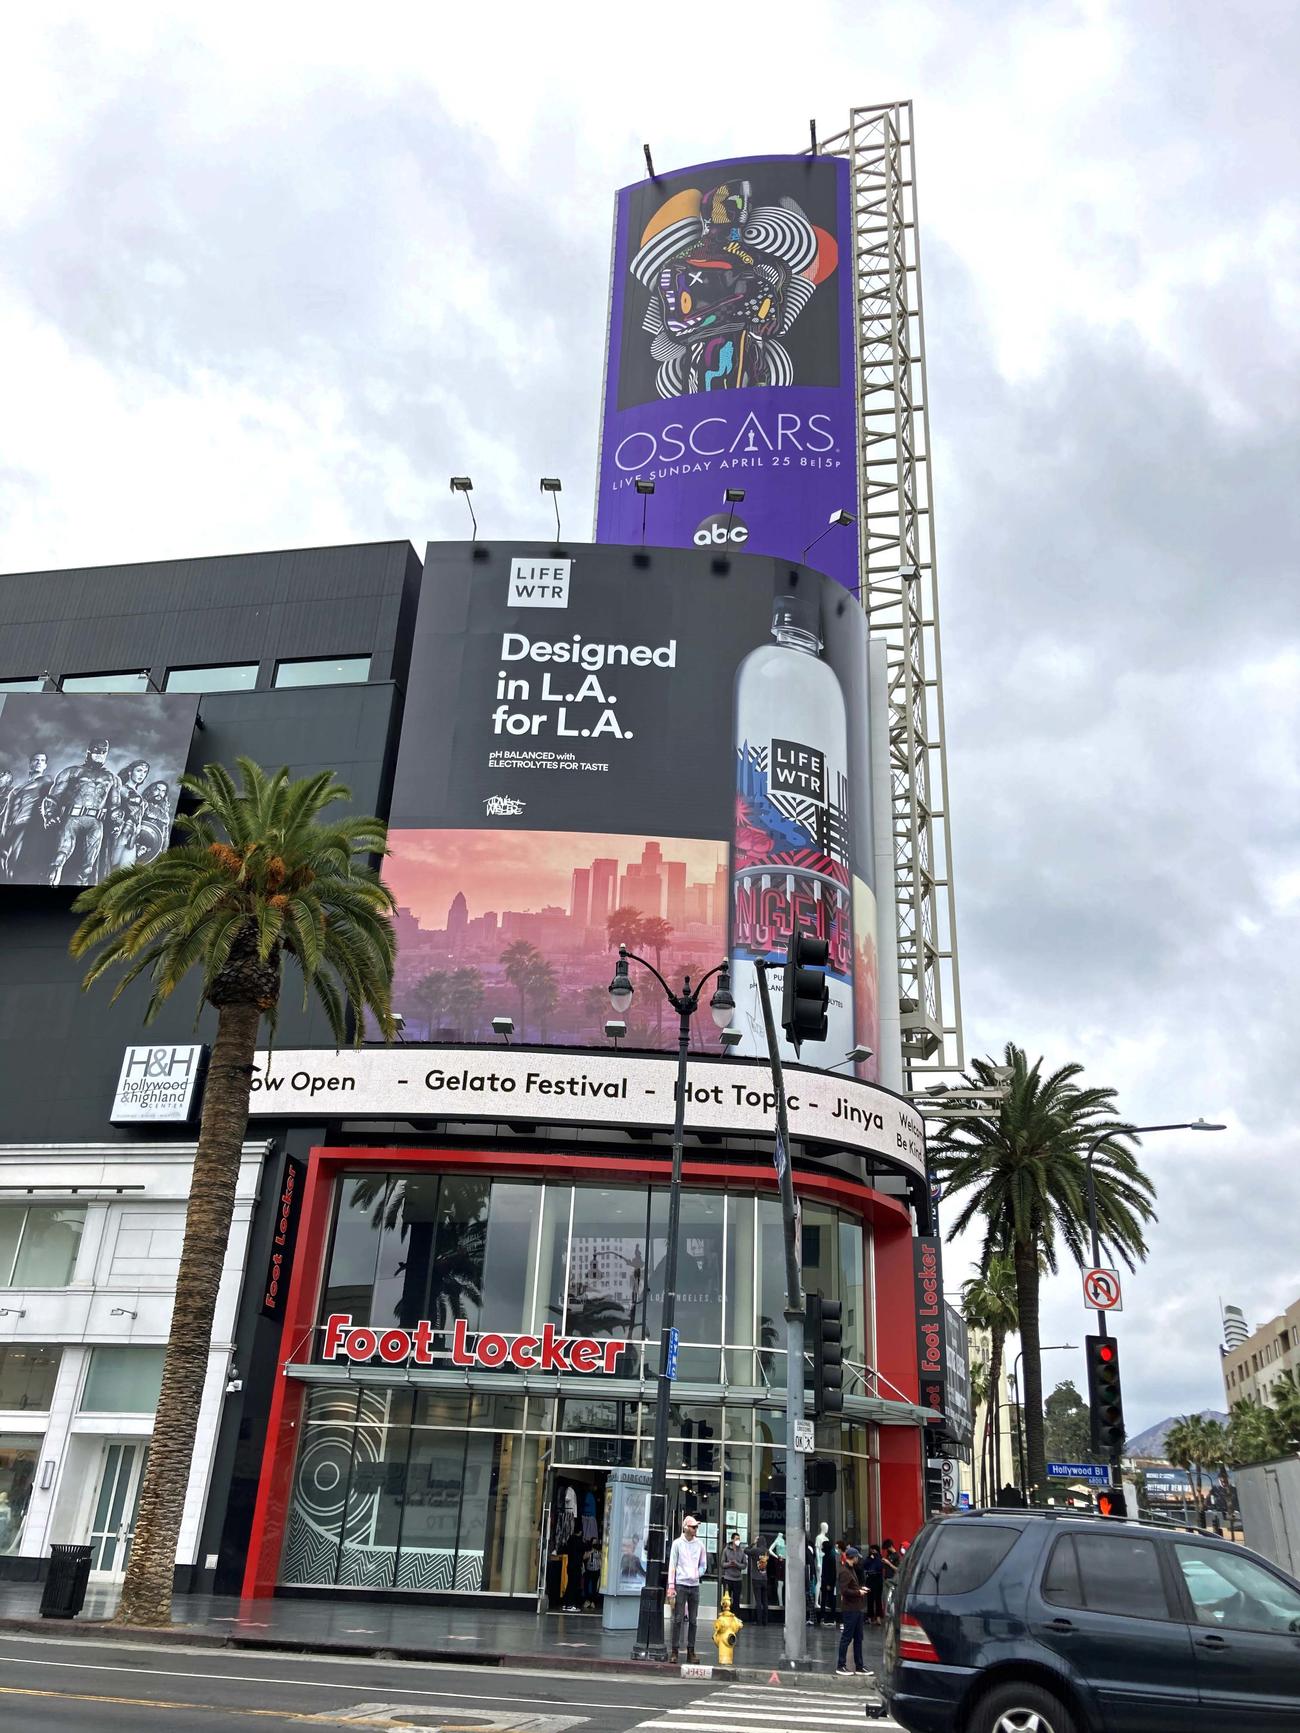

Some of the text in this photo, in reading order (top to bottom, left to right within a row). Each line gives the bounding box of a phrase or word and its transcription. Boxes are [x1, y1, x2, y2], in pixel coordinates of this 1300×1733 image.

[615, 411, 835, 471] OSCARS
[649, 461, 711, 480] SUNDAY
[719, 457, 764, 469] APRIL
[772, 456, 791, 466] 25
[693, 523, 749, 546] abc
[516, 567, 565, 581] LIFE
[515, 585, 564, 599] WTR
[501, 633, 677, 671] Designed
[496, 670, 617, 704] in L.A.
[492, 705, 634, 740] for L.A.
[488, 760, 609, 771] ELECTROLYTES FOR TASTE
[489, 751, 576, 761] pH BALANCED with
[776, 748, 821, 773] LIFE
[776, 767, 821, 793] WTR
[126, 1048, 195, 1078] H&H
[123, 1078, 189, 1094] hollywood
[120, 1090, 187, 1109] &highland
[250, 1077, 286, 1092] ow
[291, 1072, 356, 1097] Open
[425, 1069, 516, 1093] Gelato
[525, 1073, 628, 1099] Festival
[674, 1081, 724, 1105] Hot
[731, 1085, 800, 1114] Topc
[831, 1097, 884, 1131] Jinya
[896, 1132, 908, 1151] Be
[265, 1164, 297, 1308] Foot Locker
[918, 1244, 941, 1372] Foot Locker
[322, 1314, 434, 1364] Foot
[451, 1319, 626, 1374] Locker
[622, 1472, 651, 1484] DIRECTO
[1053, 1465, 1103, 1476] Hollywood Bl
